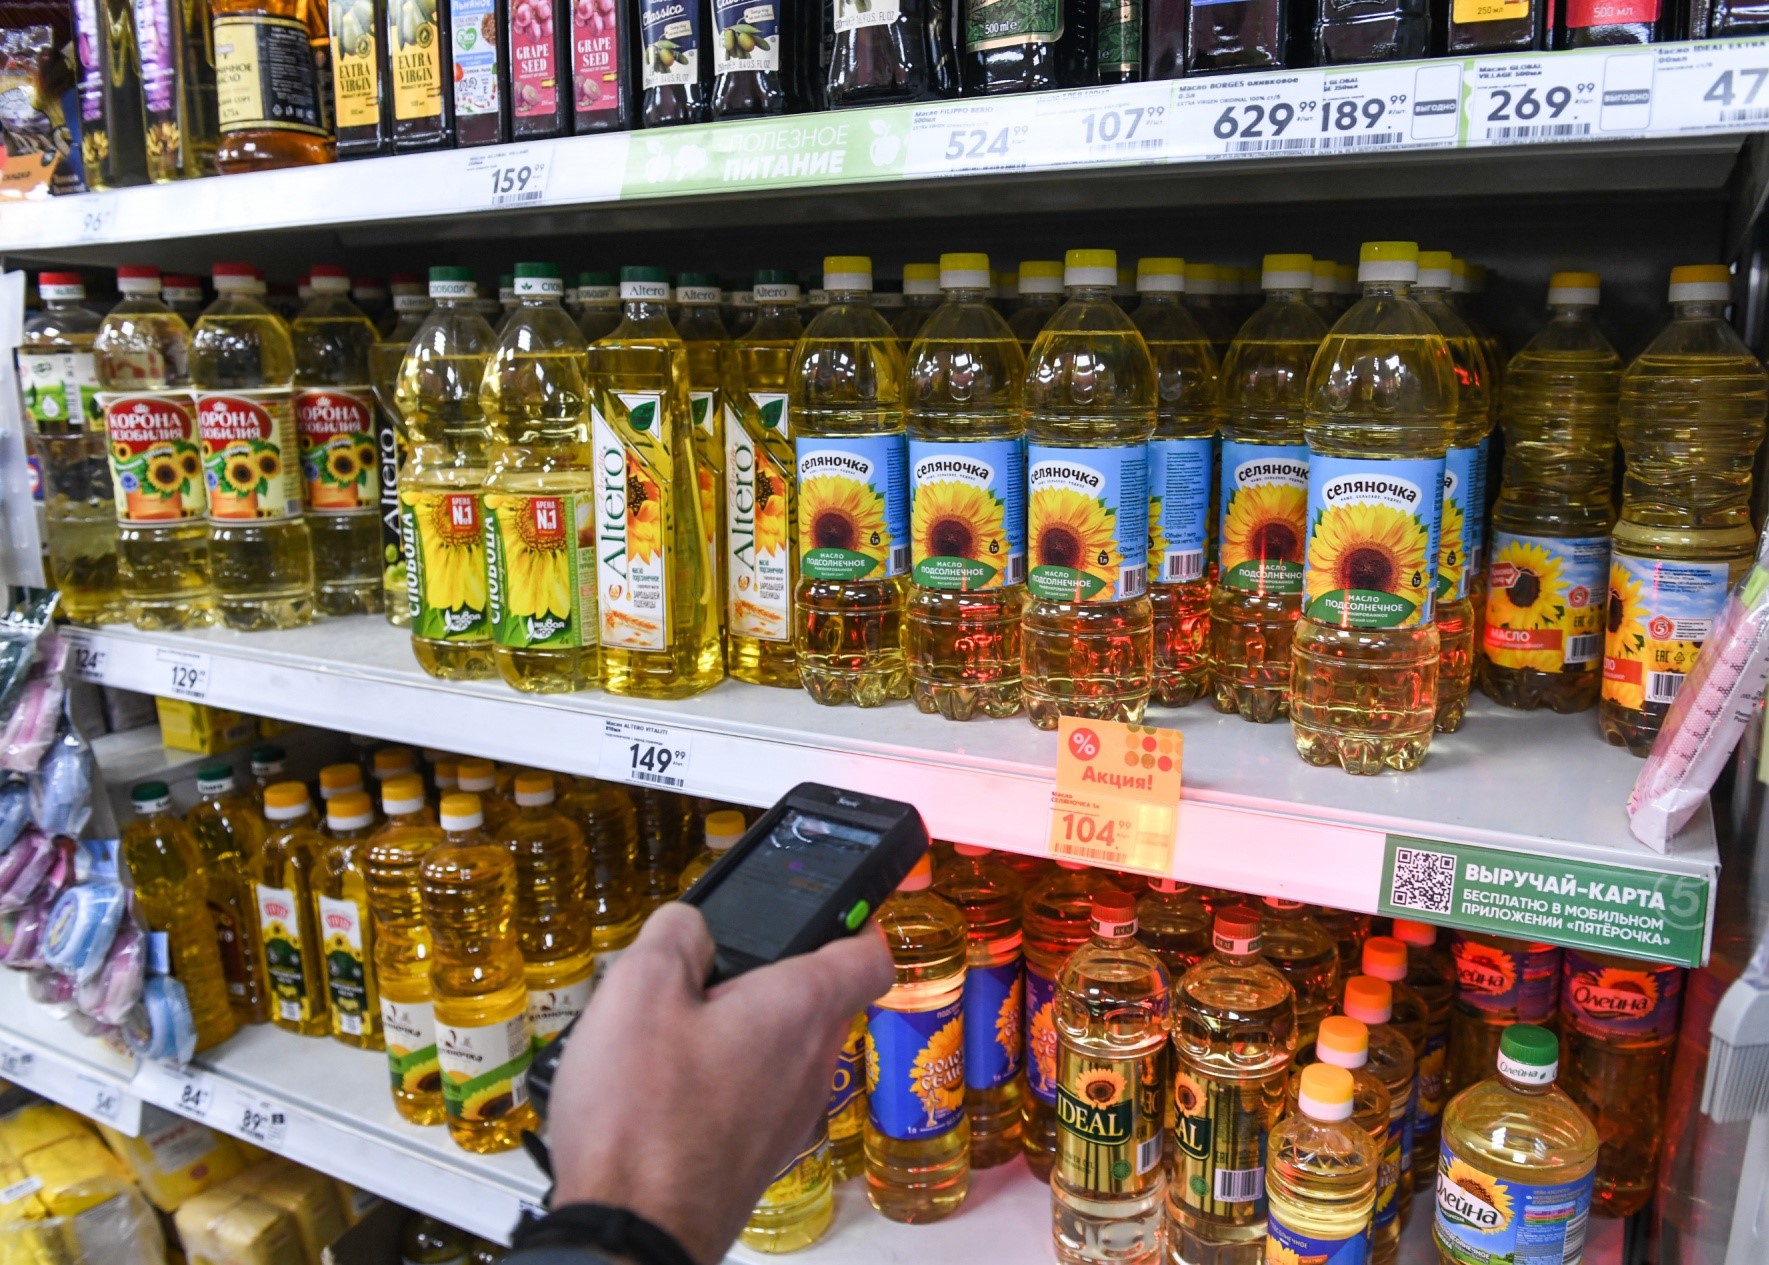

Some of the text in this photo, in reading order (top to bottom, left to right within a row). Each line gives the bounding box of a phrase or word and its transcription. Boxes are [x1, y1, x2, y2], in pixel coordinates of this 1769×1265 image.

[643, 4, 684, 25] Classico
[1477, 5, 1504, 15] 250 мл
[1592, 5, 1633, 18] 500 мл
[985, 23, 999, 34] 500
[516, 43, 549, 60] GRAPE
[577, 37, 611, 53] GRAPE
[1694, 40, 1767, 54] IDEAL EXTRA
[398, 52, 433, 69] EXTRA
[521, 59, 547, 73] SEED
[582, 52, 609, 66] SEED
[339, 63, 371, 78] EXTRA
[399, 67, 434, 84] VIRGIN
[1478, 71, 1512, 80] VILLAGE
[1480, 63, 1542, 73] Масло GLOBAL
[340, 78, 371, 92] VIRGIN
[1179, 77, 1299, 92] Масло BORGES оливковое
[1329, 77, 1359, 86] GLOBAL
[1334, 84, 1359, 92] 250мл
[1576, 82, 1595, 94] 99
[1390, 94, 1407, 105] 99
[1486, 86, 1573, 122] 269
[1604, 90, 1649, 104] ВЫГОДНО
[915, 109, 939, 118] Масло
[940, 107, 969, 116] FILIPPO
[1146, 106, 1165, 117] 99
[1299, 101, 1317, 112] 99
[1415, 101, 1456, 113] ВЫГОДНО
[1213, 101, 1295, 140] 629
[1321, 98, 1386, 132] 189
[1013, 125, 1029, 136] 99
[1081, 107, 1145, 144] 107
[728, 124, 850, 153] ПОЛЕЗНОЕ
[945, 127, 1009, 161] 524
[534, 163, 546, 172] 99
[722, 149, 847, 182] ПИТАНИЕ
[491, 165, 532, 194] 159
[630, 285, 666, 297] Altero
[683, 290, 715, 301] Altero
[755, 284, 787, 297] Altero
[110, 411, 182, 430] КОРОНА
[111, 427, 183, 442] ИЗОБИЛИЯ
[801, 456, 869, 474] селяночка
[916, 461, 989, 480] селяночка
[1238, 463, 1310, 482] селяночк
[381, 428, 400, 535] Altero
[1031, 467, 1099, 488] селяночка
[1327, 481, 1417, 504] селяночка
[452, 496, 471, 506] БРЕНД
[535, 500, 555, 508] БРЕНД
[732, 445, 756, 571] Altero
[600, 446, 628, 580] Altero
[990, 544, 999, 553] 1л
[402, 512, 422, 617] СЛОБОДА
[806, 556, 865, 568] ПОДСОЛНЕЧНОЕ
[1099, 556, 1108, 564] 1л
[920, 566, 984, 577] ПОДСОЛНЕЧНОЕ
[1044, 570, 1070, 578] МАСЛО
[1239, 568, 1303, 580] ПОДСОЛНЕЧНО
[1031, 575, 1092, 588] ПОДСОЛНЕЧНОЕ
[1325, 599, 1404, 613] ПОДСОЛНЕЧНОЕ
[1348, 594, 1380, 603] МАСЛО
[1491, 628, 1531, 643] МАСЛО
[75, 649, 99, 669] 124
[172, 666, 198, 688] 129
[606, 720, 668, 735] Масло ALTERO VITALITI
[630, 743, 673, 774] 149
[674, 750, 686, 760] 99
[1081, 765, 1154, 791] Акция!
[1051, 791, 1073, 799] Масло
[1050, 797, 1091, 809] СЕЛЯНОЧКА
[1062, 813, 1115, 847] 104
[1118, 820, 1132, 830] 99
[1464, 862, 1666, 911] ВЫРУЧАЙ-КАРТА
[1463, 887, 1664, 931] БЕСПЛАТНО В МОБИЛЬНОМ
[1460, 901, 1671, 946] ПРИЛОЖЕНИИ «ПЯТЁРОЧКА»
[1573, 986, 1649, 1013] Олейна
[1500, 1061, 1538, 1078] Олейна
[181, 1085, 200, 1103] 84
[242, 1109, 261, 1129] 89
[1057, 1092, 1125, 1138] IDEAL
[907, 1126, 917, 1135] 1л
[1437, 1171, 1499, 1227] Олейна
